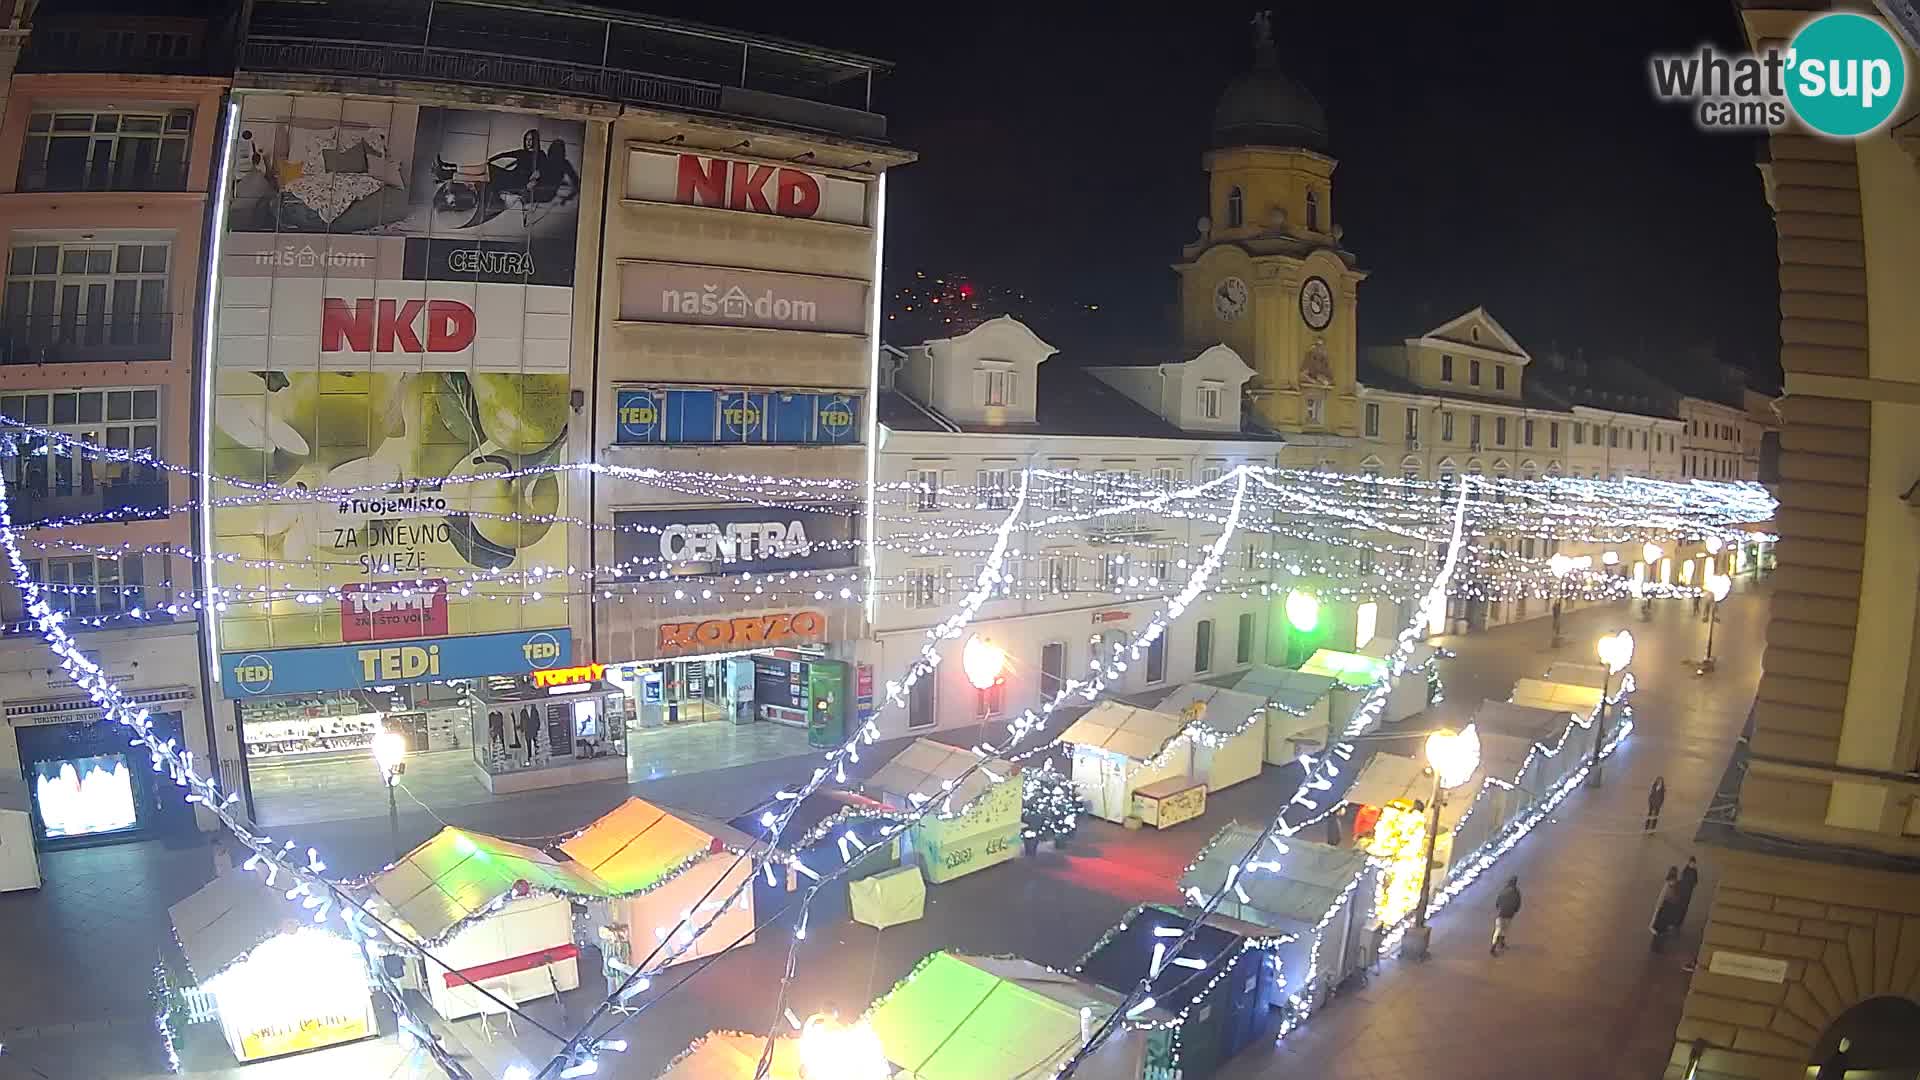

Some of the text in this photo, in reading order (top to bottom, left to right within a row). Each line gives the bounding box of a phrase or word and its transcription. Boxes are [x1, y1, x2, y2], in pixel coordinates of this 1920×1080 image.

[676, 152, 821, 218] NKD
[255, 245, 366, 268] naš dom
[448, 248, 536, 275] CENTRA
[661, 284, 817, 322] naš dom
[321, 298, 477, 353] NKD
[618, 407, 658, 425] TEDi
[723, 408, 760, 425] TEDi
[820, 411, 854, 426] TEDi
[339, 496, 446, 516] #TvojeMisto
[334, 523, 451, 549] ZA DNEVNO
[659, 520, 811, 562] CENTRA
[659, 611, 826, 650] KORZO
[359, 645, 440, 680] TEDi
[522, 642, 560, 659] TEDi
[234, 666, 273, 683] TEDi
[531, 663, 605, 688] TOMMY
